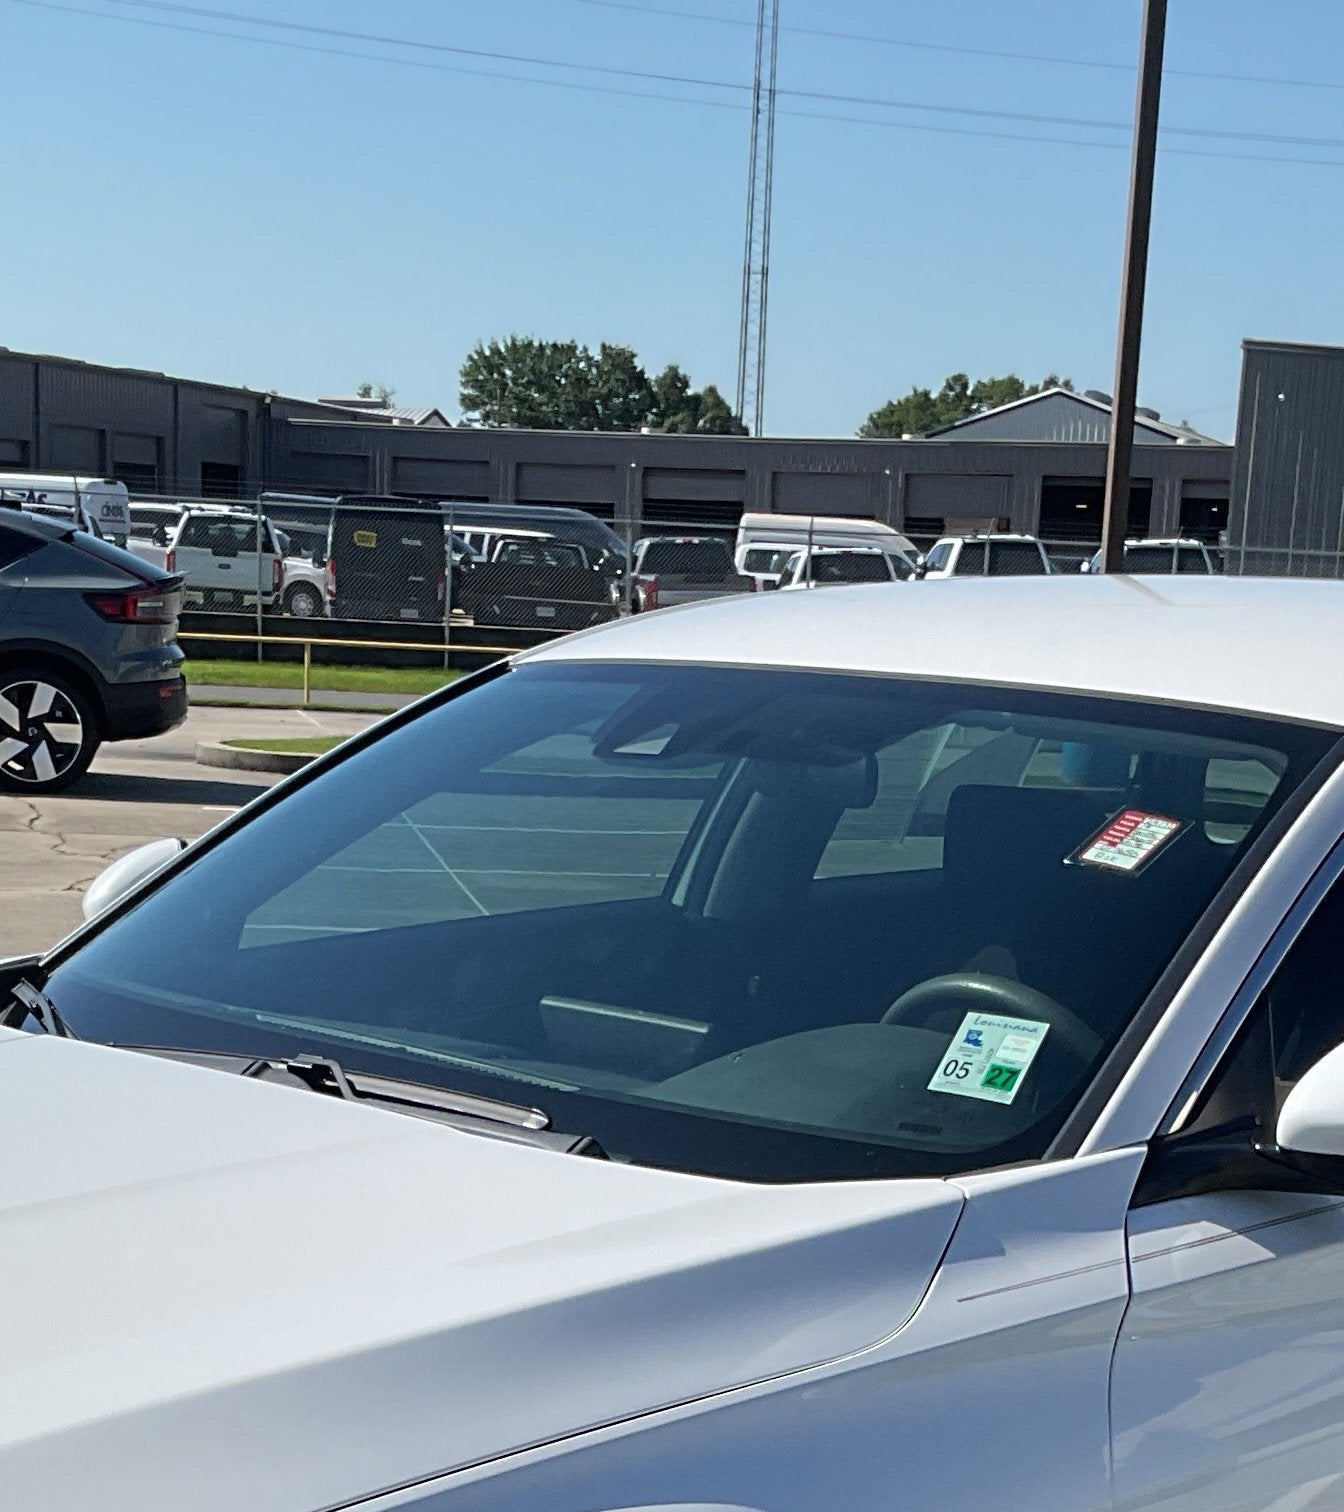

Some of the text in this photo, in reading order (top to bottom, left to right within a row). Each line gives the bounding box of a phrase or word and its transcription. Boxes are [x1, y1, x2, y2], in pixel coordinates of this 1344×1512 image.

[974, 1015, 1038, 1033] Louisiana
[943, 1059, 973, 1079] 05
[984, 1066, 1021, 1088] 27
